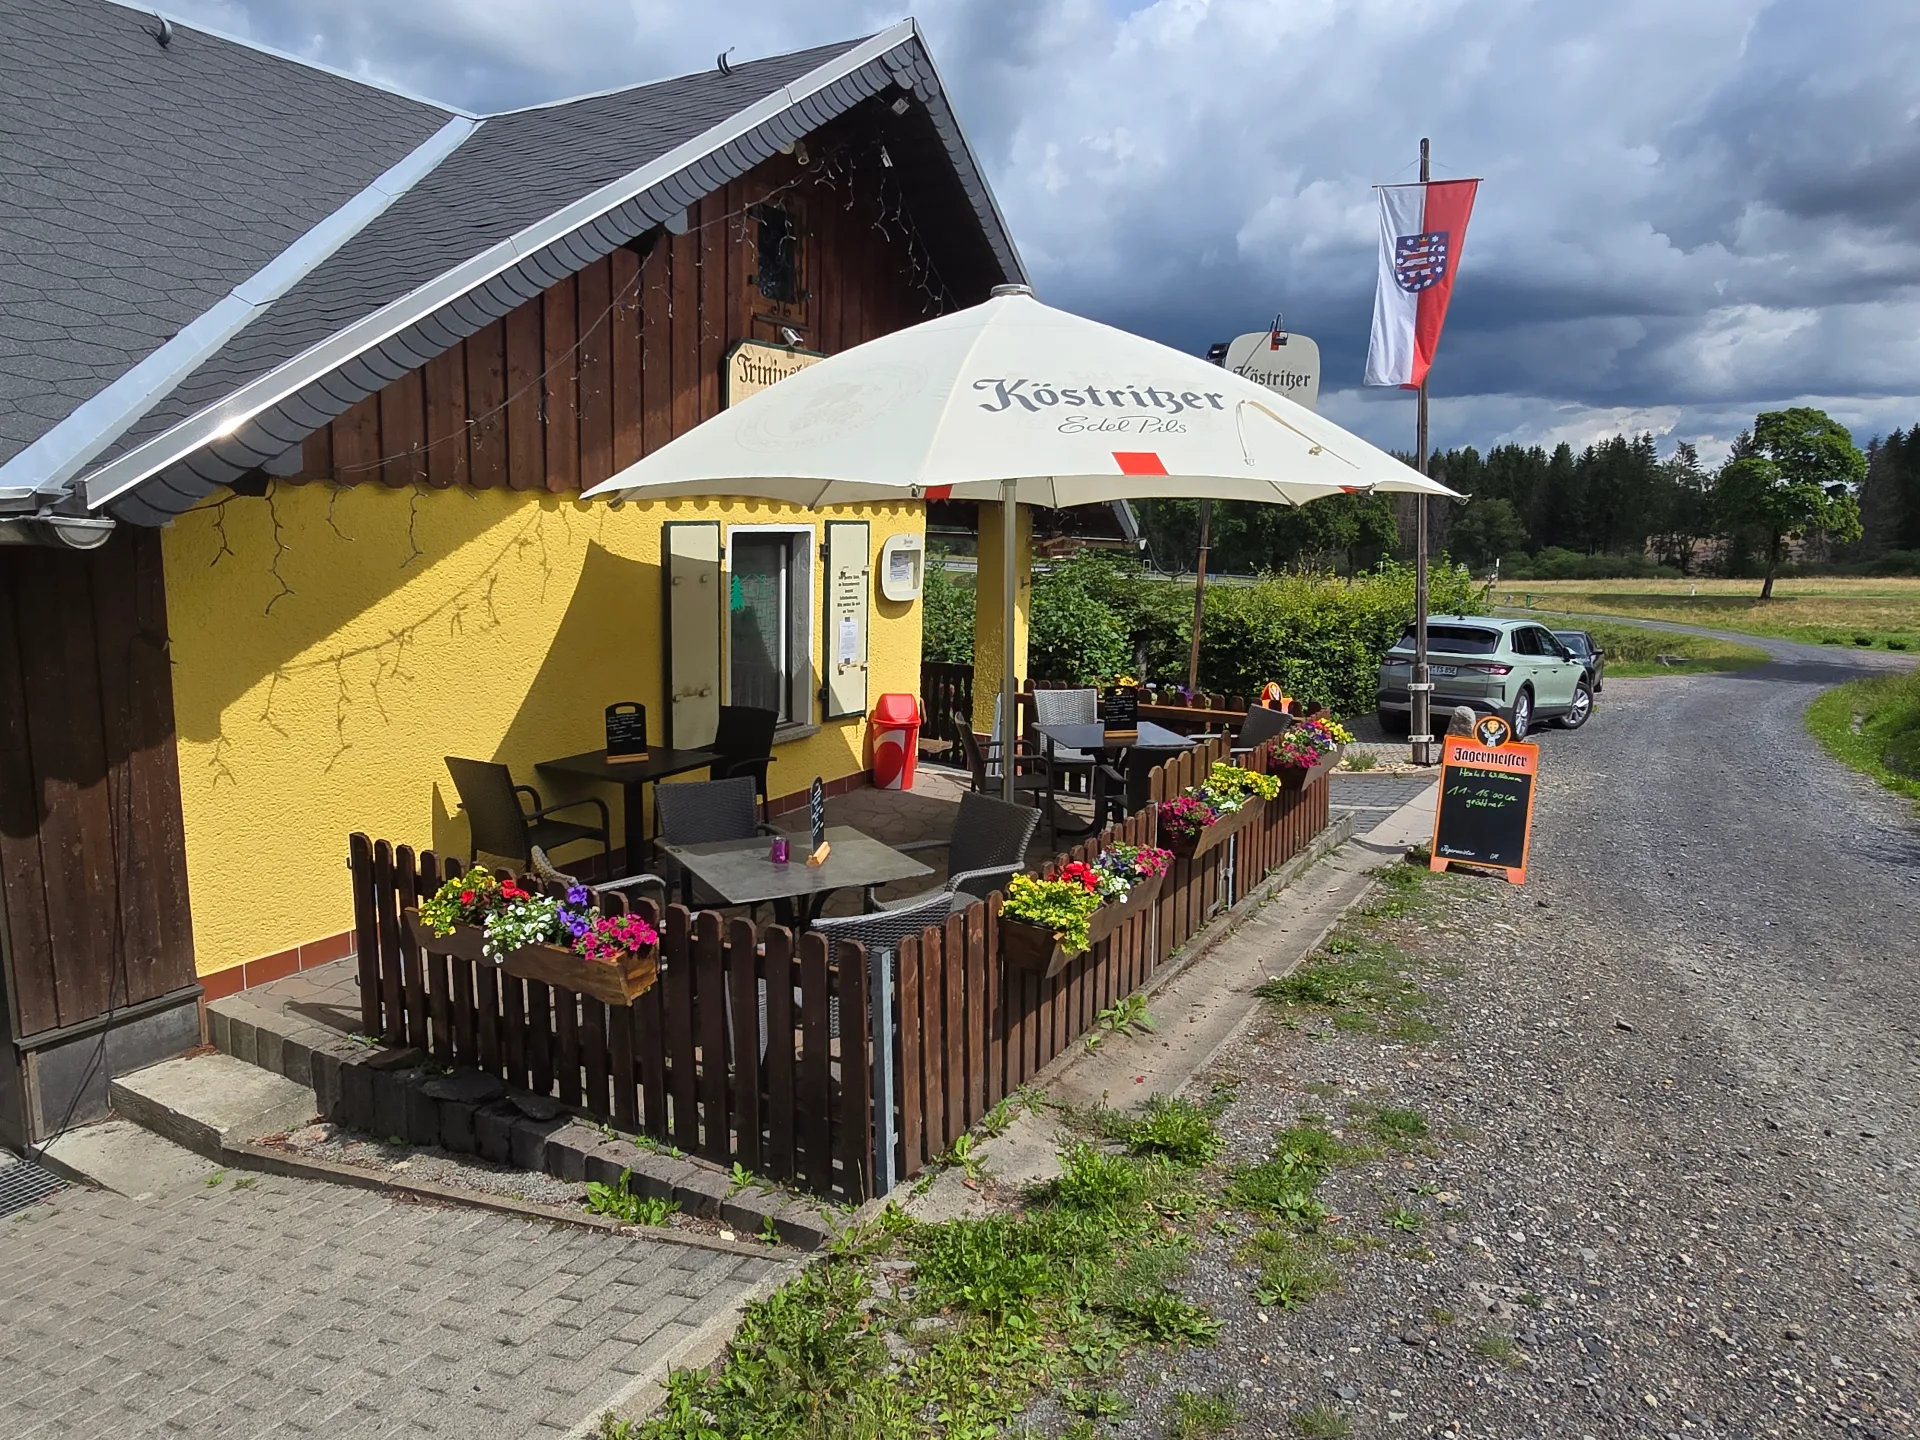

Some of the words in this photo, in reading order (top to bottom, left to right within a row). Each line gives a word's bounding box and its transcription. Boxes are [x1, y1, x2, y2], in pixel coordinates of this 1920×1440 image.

[972, 378, 1225, 415] Köstritzer
[1057, 415, 1131, 434] Edel
[1117, 415, 1188, 434] Pils
